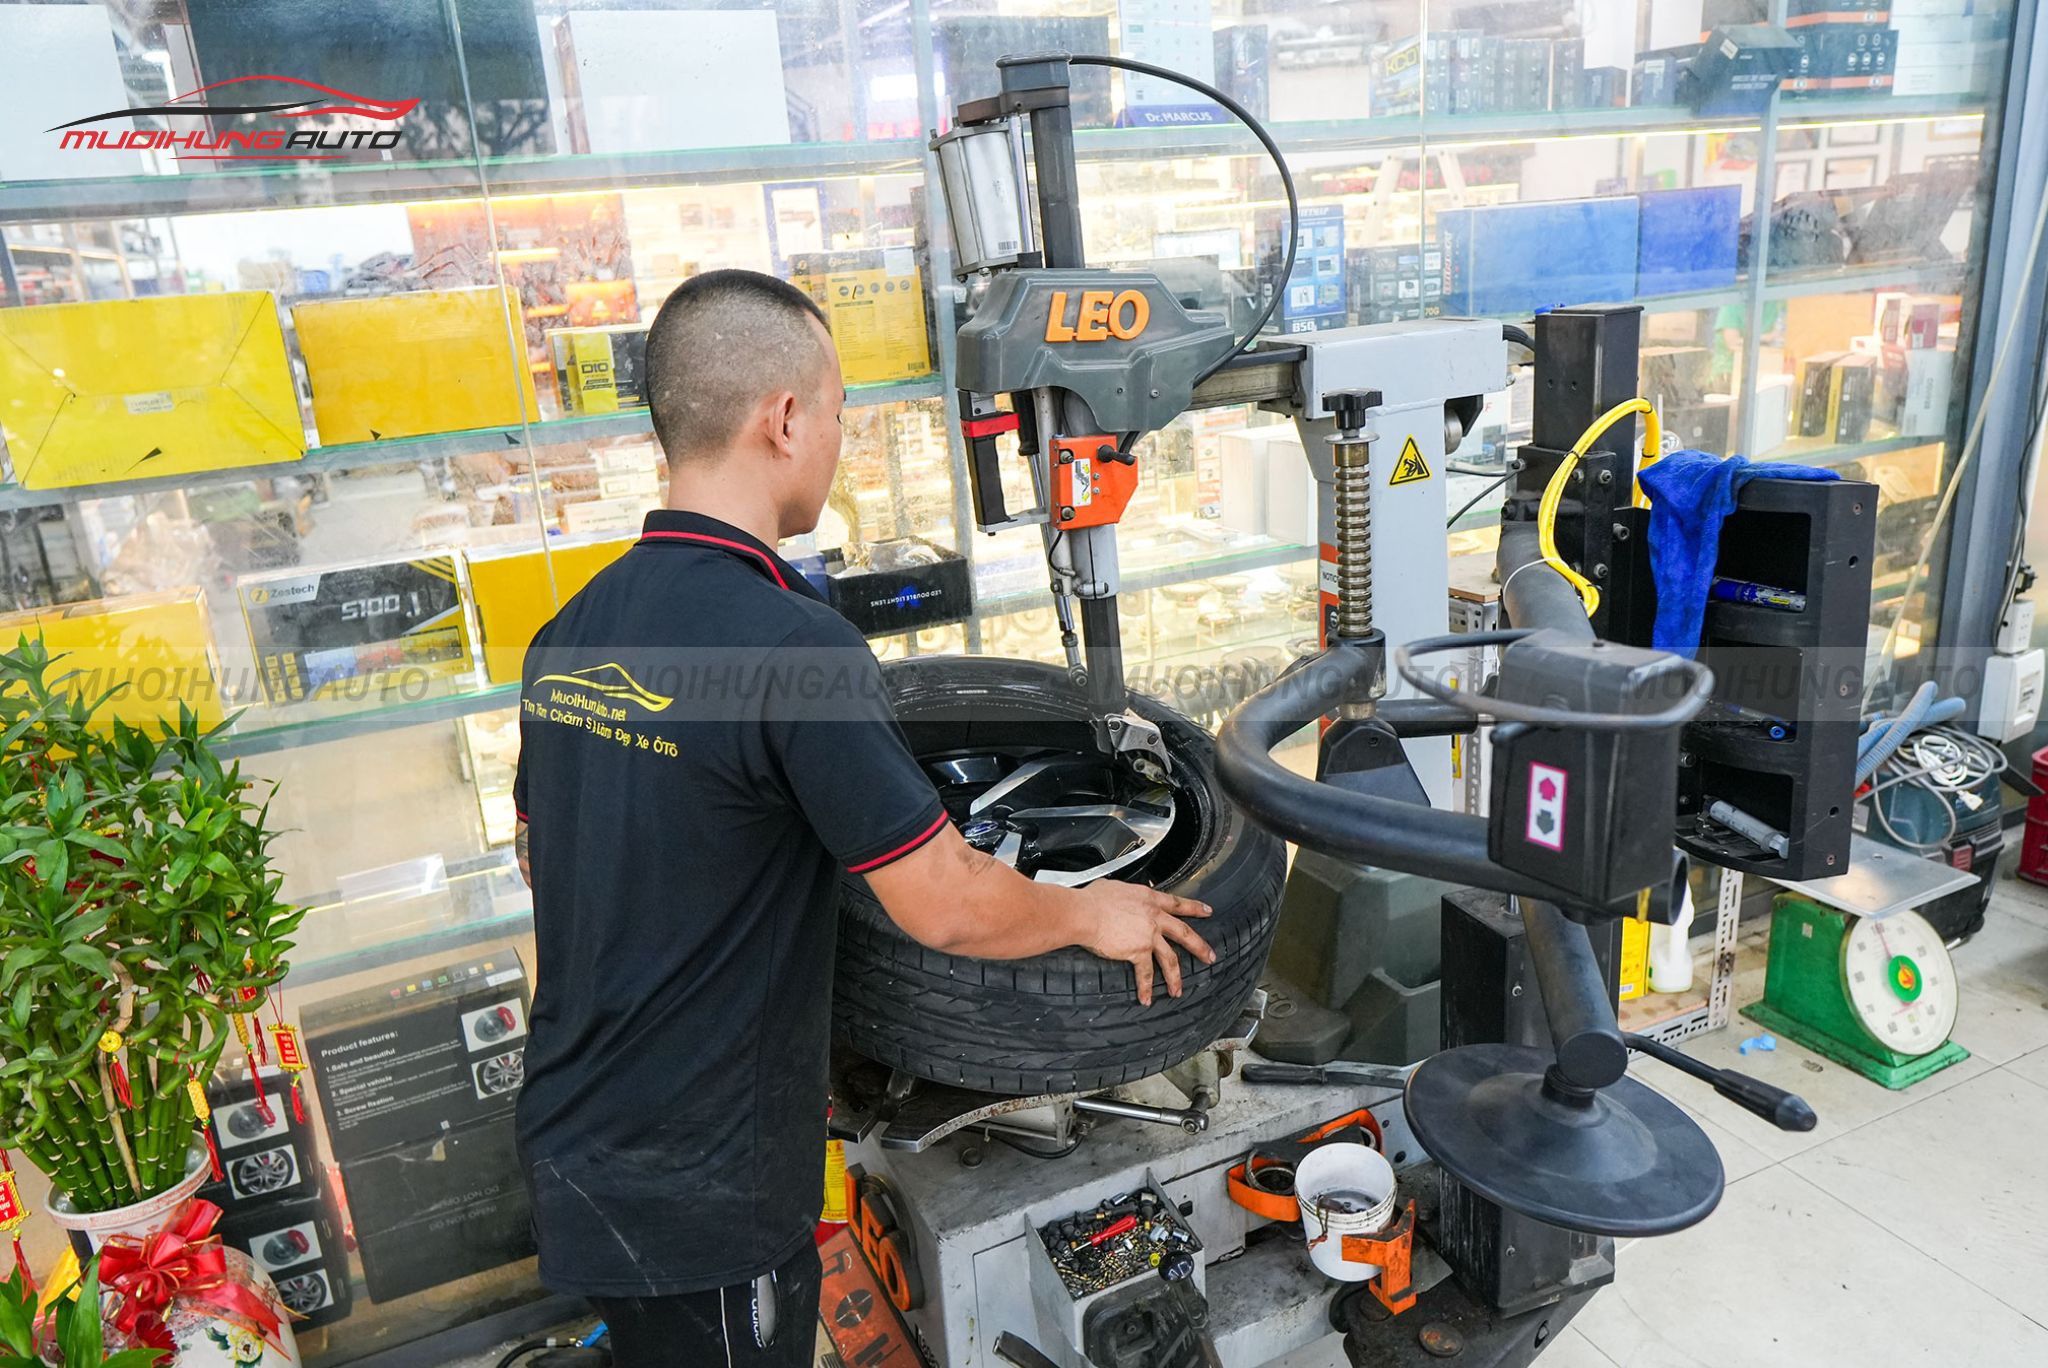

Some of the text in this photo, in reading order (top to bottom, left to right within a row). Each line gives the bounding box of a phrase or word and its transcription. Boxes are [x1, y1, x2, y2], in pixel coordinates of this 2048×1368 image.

[1145, 111, 1213, 122] Dr.MARCUS
[1045, 289, 1151, 342] LEO
[270, 584, 315, 598] Zestech
[870, 589, 942, 607] LED DOUBLE LIGHT LENS
[550, 707, 583, 727] Chăm
[636, 733, 650, 750] Xe
[321, 1031, 399, 1058] Product features:
[349, 1058, 364, 1067] and
[364, 1048, 396, 1063] beautiful
[339, 1082, 367, 1097] Special
[367, 1075, 393, 1088] vehicle
[845, 1166, 913, 1313] LEO
